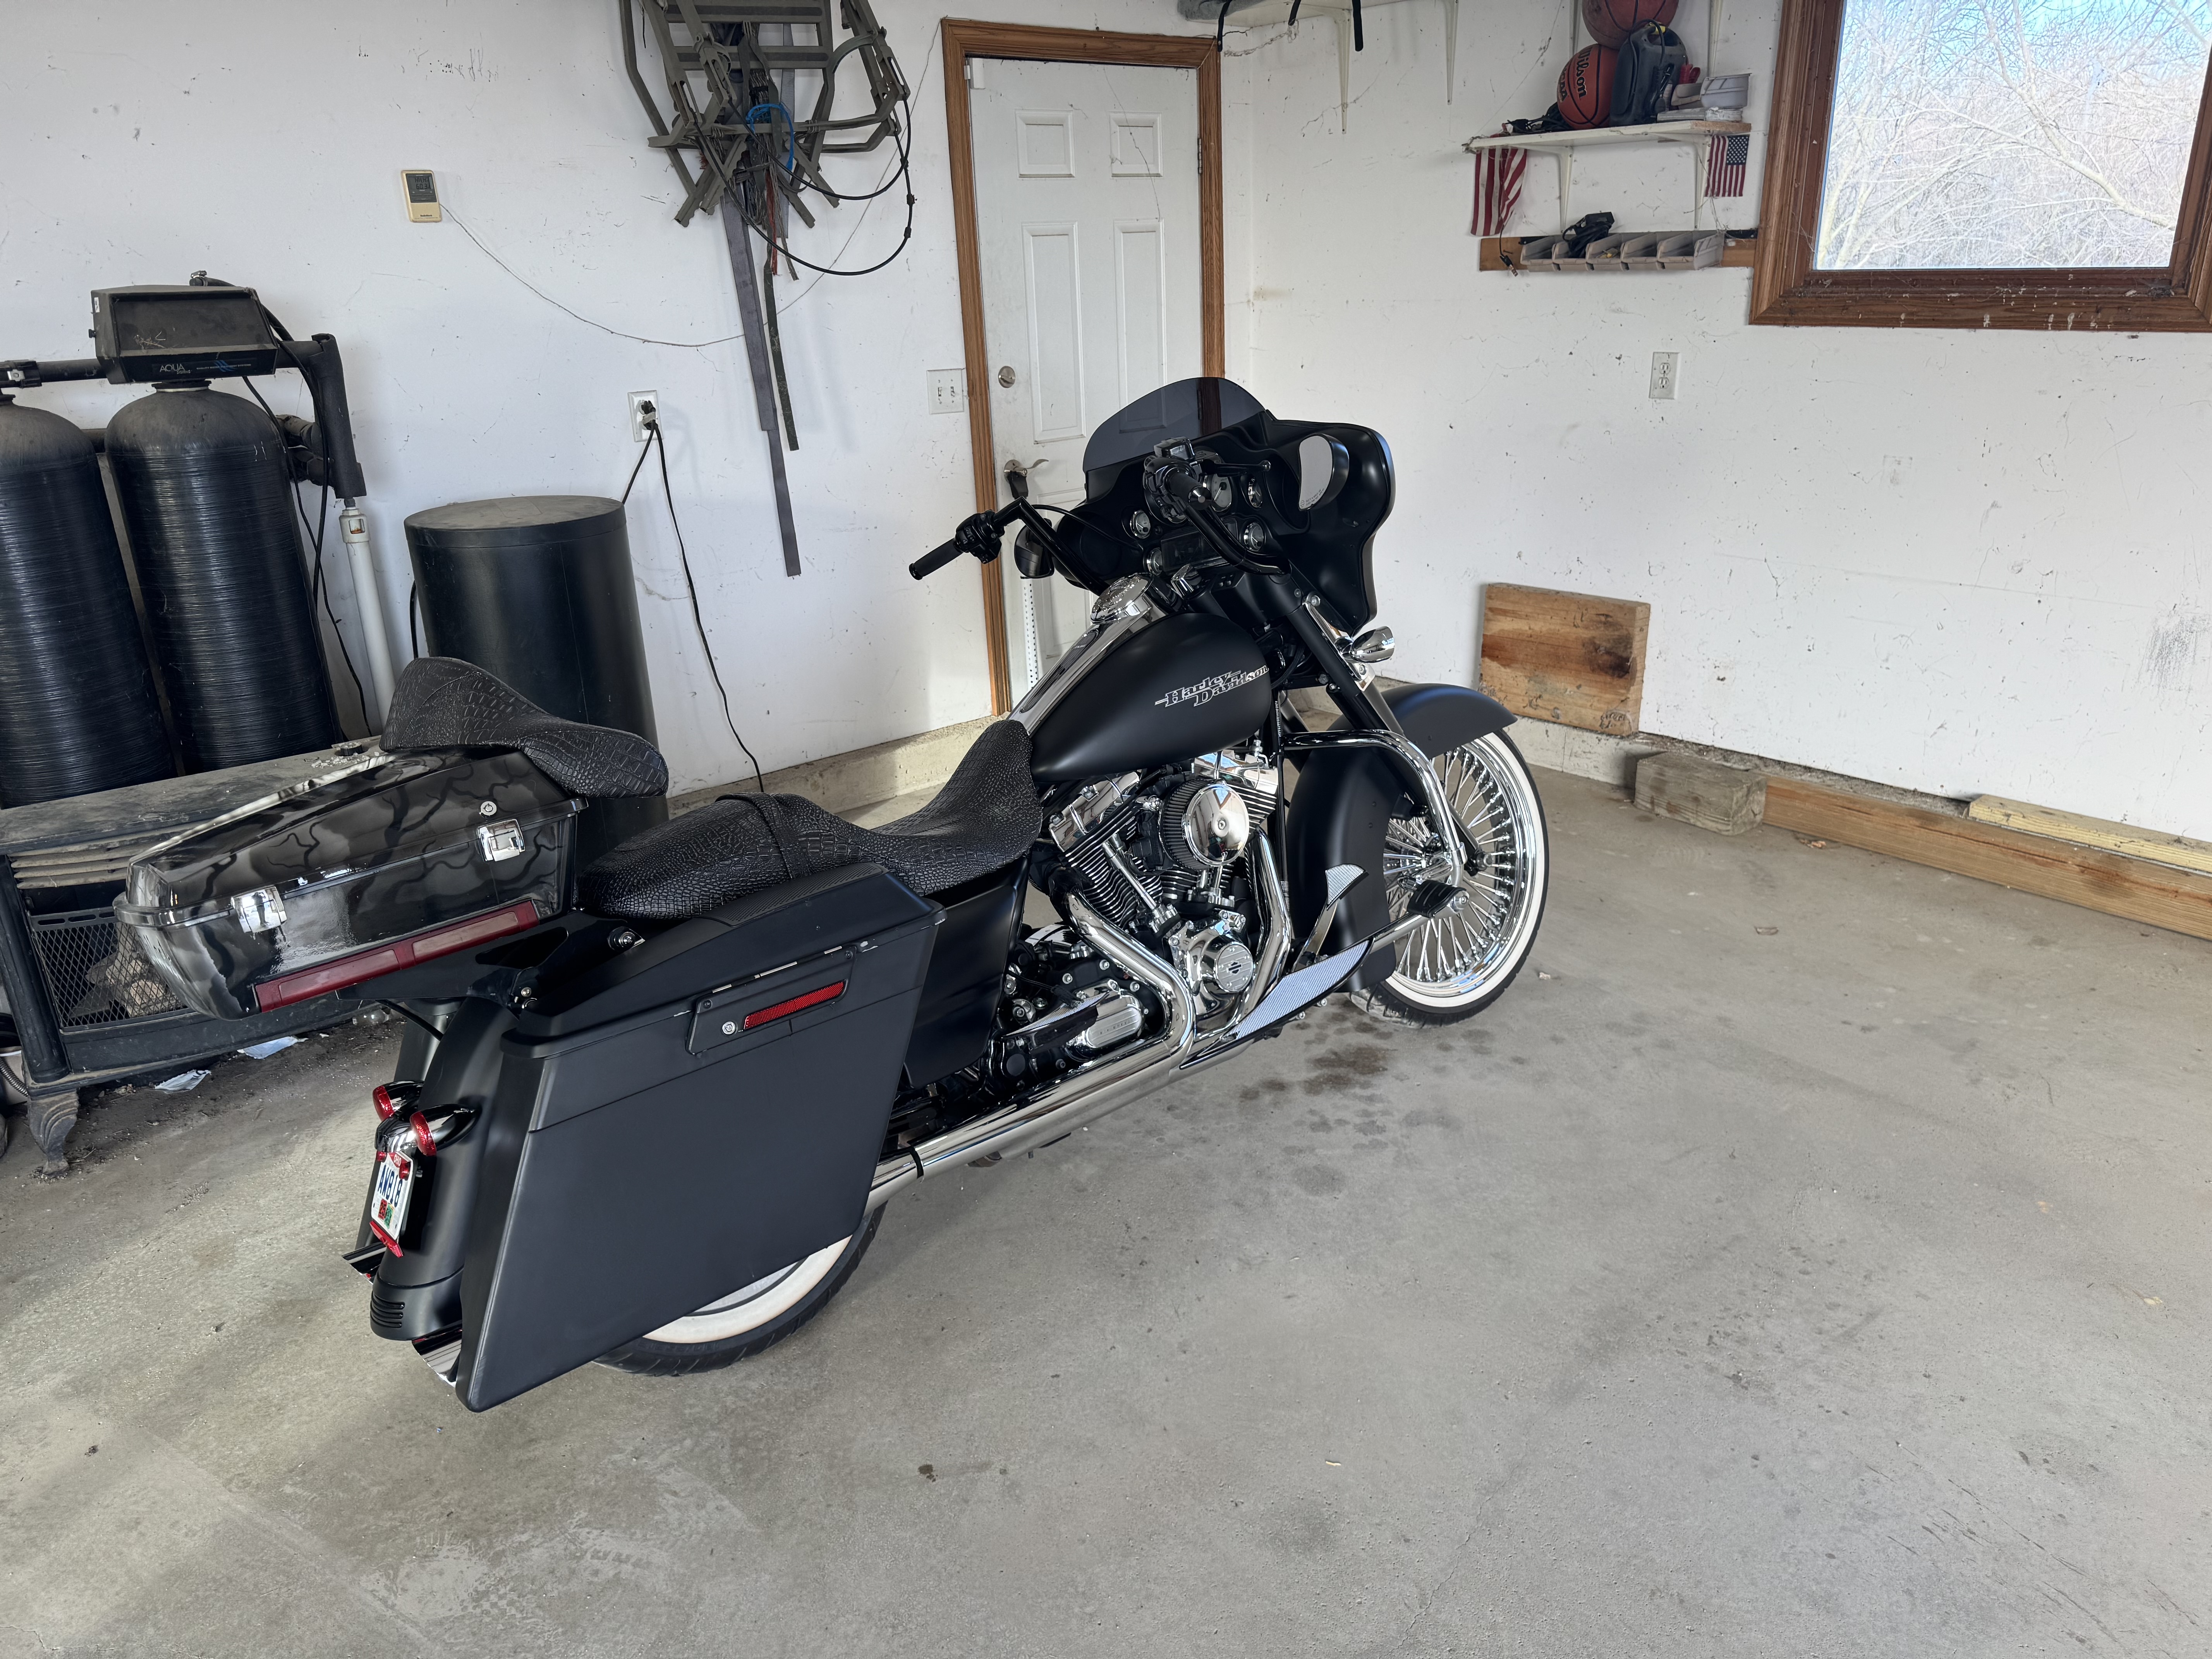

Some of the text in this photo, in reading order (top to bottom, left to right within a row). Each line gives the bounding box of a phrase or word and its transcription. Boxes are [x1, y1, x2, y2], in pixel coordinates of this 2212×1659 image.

[1576, 46, 1593, 98] Wilson
[160, 364, 185, 372] AQUA
[1164, 671, 1232, 707] Harley
